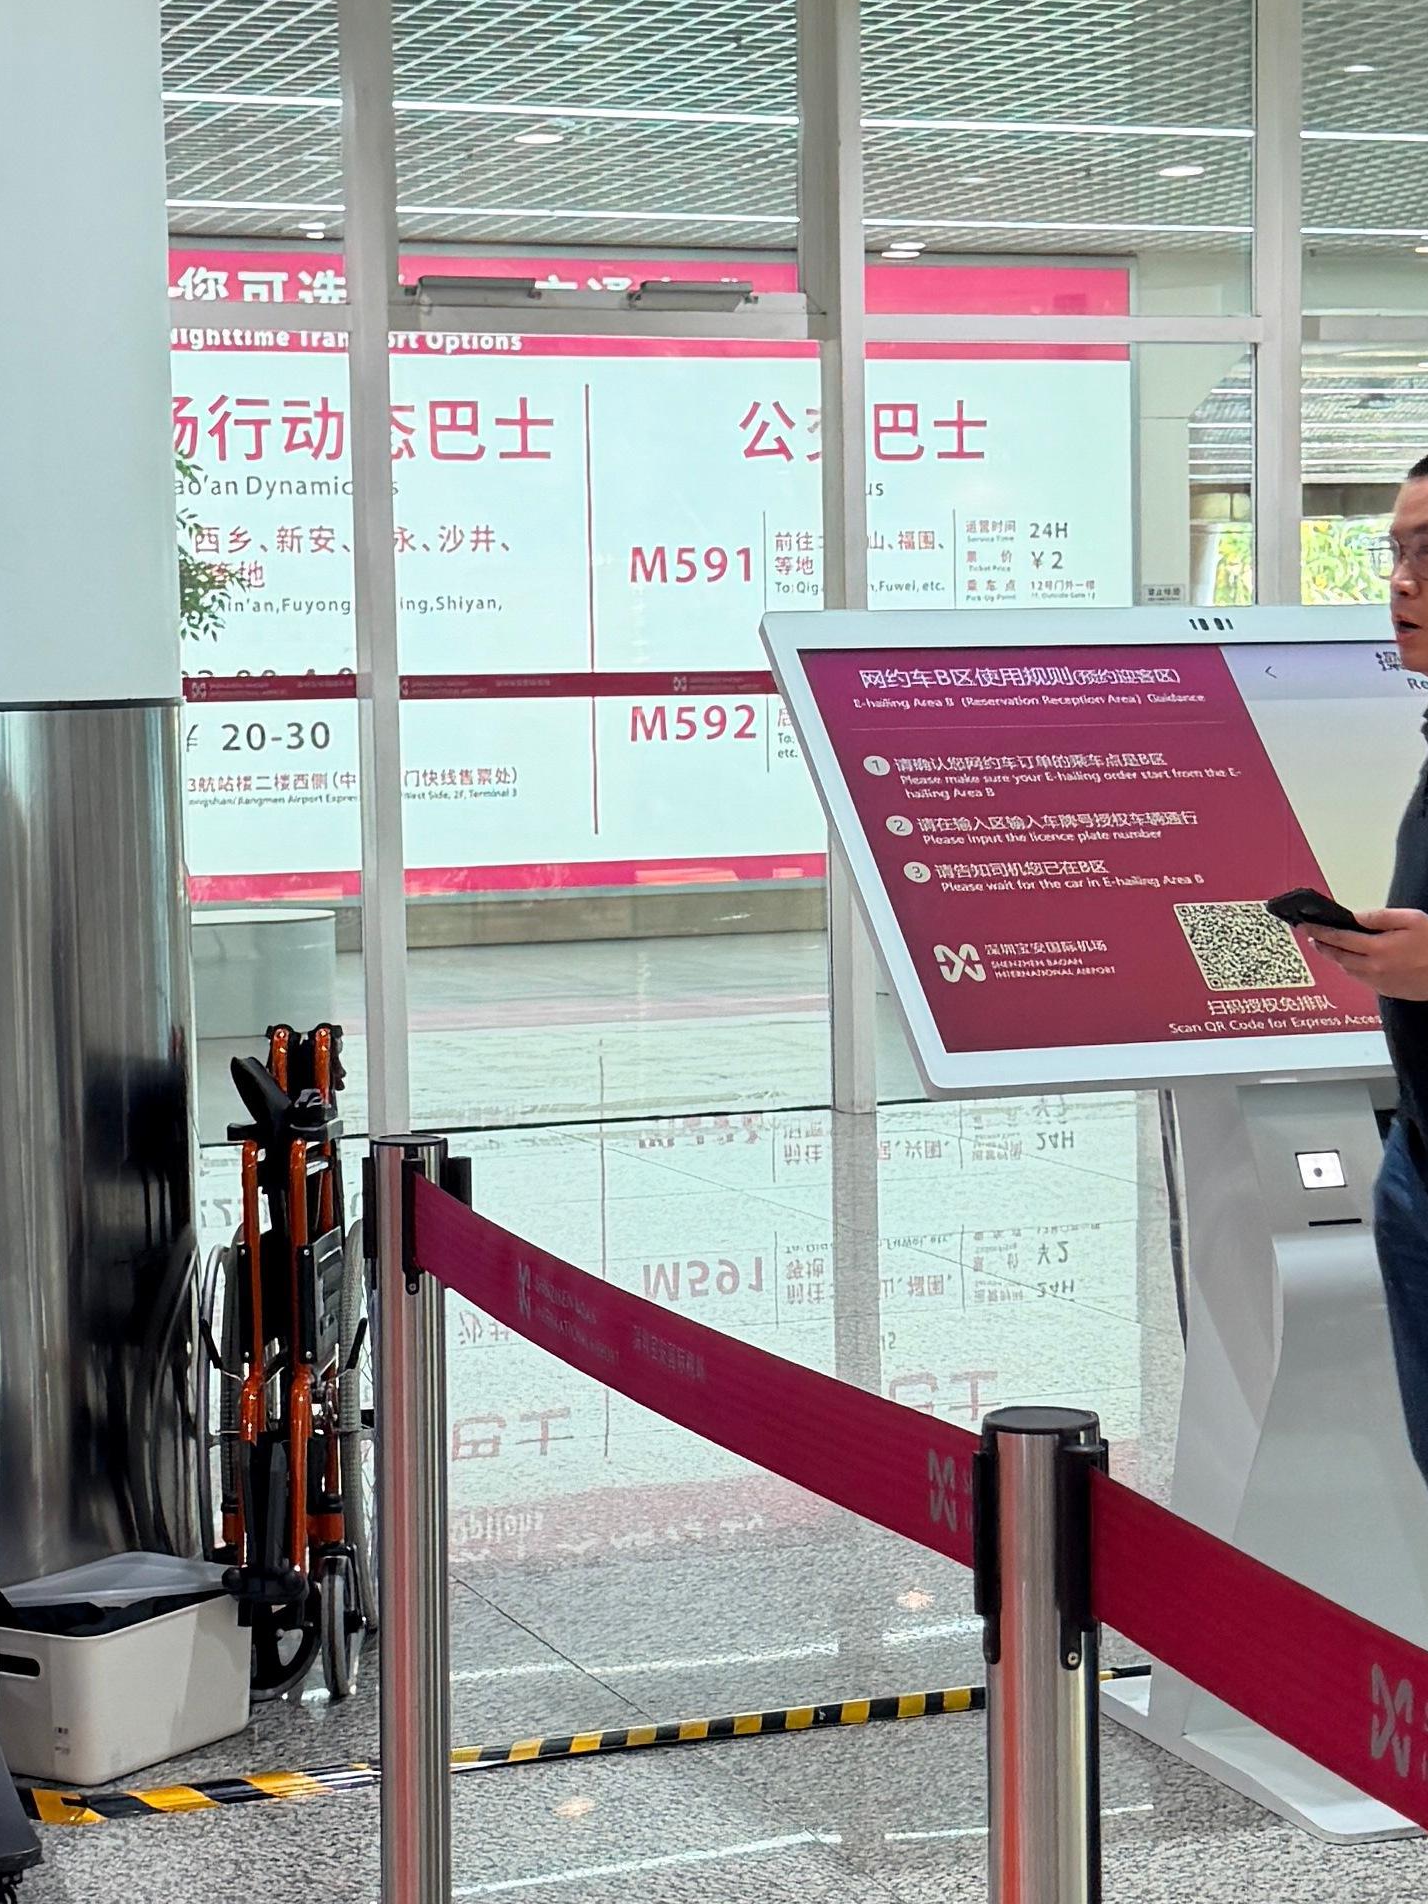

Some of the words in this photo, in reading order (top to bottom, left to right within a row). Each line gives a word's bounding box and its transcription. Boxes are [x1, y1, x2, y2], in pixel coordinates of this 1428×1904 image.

[174, 475, 239, 496] ao'an
[1029, 522, 1068, 538] 24H
[630, 546, 752, 584] M591
[1051, 551, 1063, 569] 2
[630, 704, 757, 742] M592
[221, 721, 330, 751] 20-30
[1169, 1022, 1202, 1034] Scan
